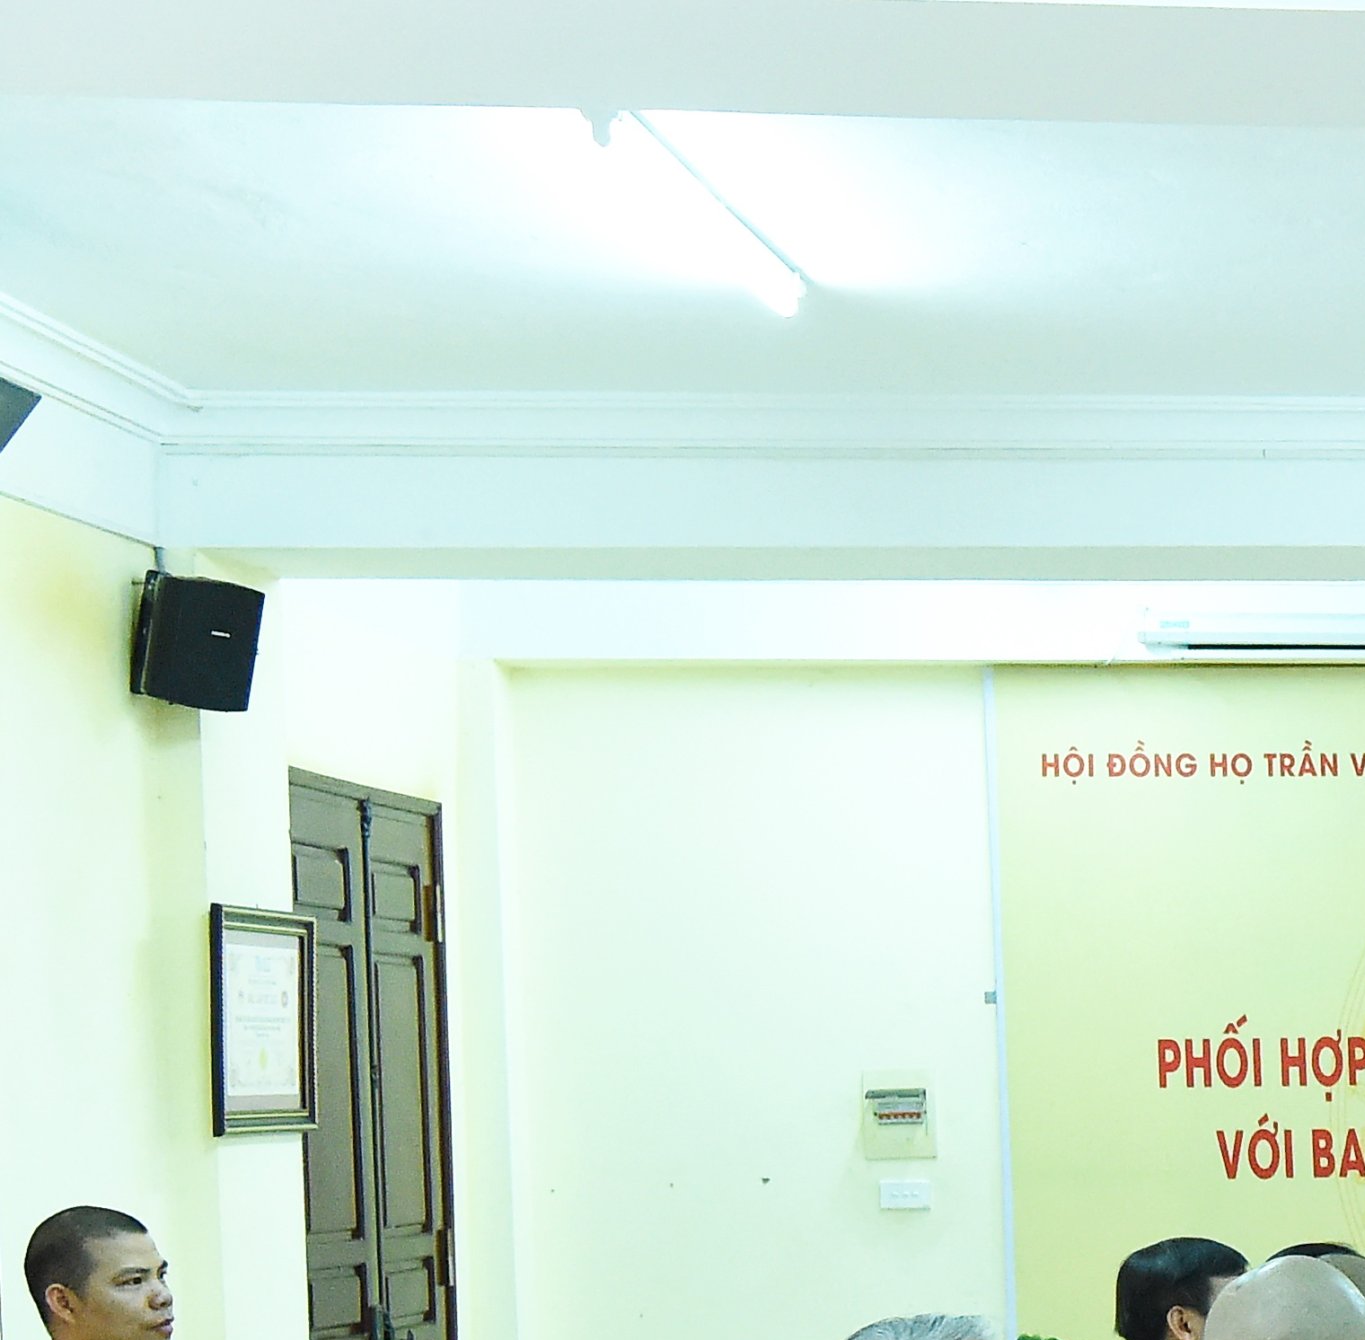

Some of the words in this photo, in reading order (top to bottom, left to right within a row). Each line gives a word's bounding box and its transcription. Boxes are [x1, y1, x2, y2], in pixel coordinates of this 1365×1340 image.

[1041, 747, 1095, 784] HỘI
[1106, 741, 1198, 777] ĐỒNG
[1210, 753, 1253, 784] HỌ
[1264, 741, 1338, 777] TRẦN
[1157, 1015, 1262, 1088] PHỐI
[1216, 1113, 1294, 1179] VỚI
